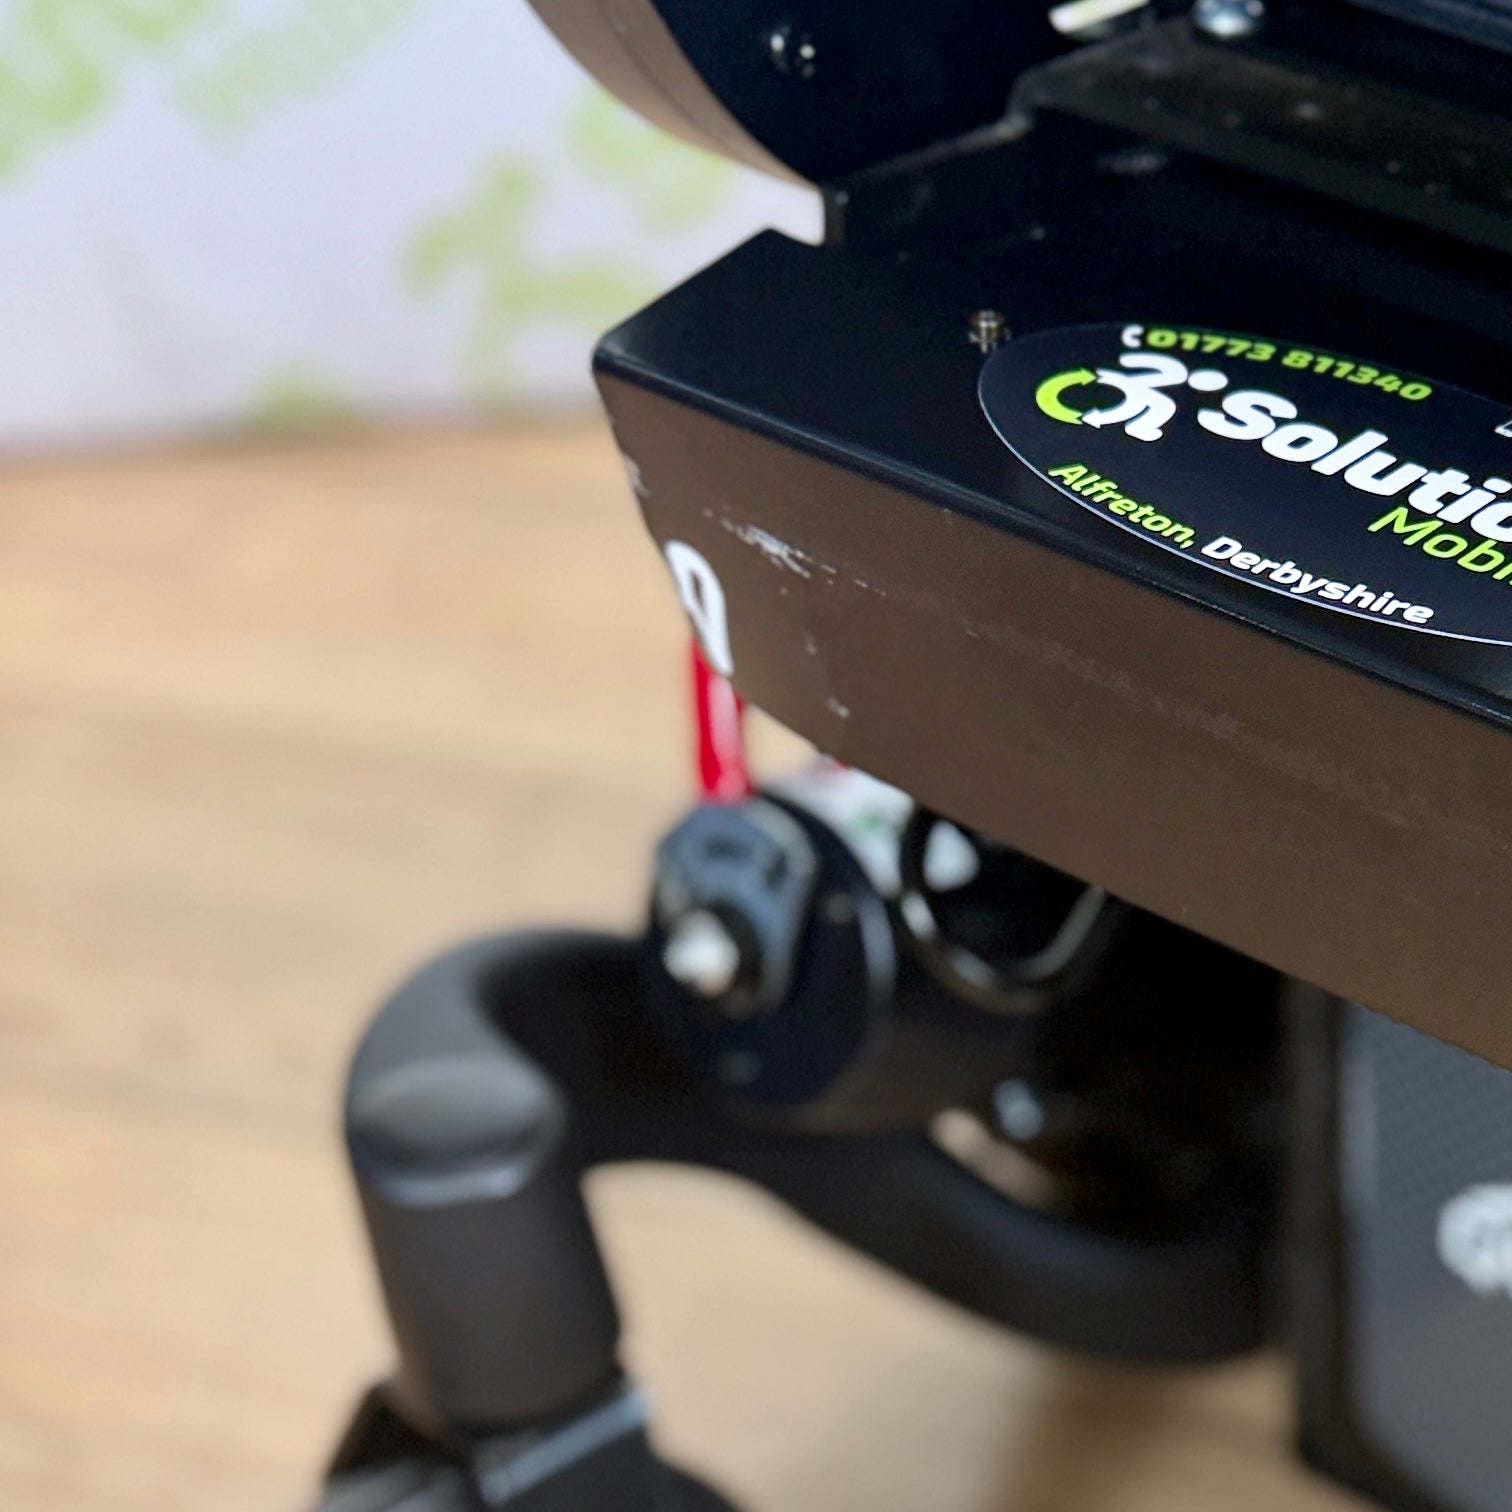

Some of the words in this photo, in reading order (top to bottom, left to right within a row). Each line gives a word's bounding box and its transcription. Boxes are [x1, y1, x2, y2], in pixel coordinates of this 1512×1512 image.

[1146, 328, 1277, 363] 01773
[1281, 349, 1433, 401] 811340
[1047, 462, 1196, 550] Alfreton,
[1200, 534, 1435, 624] Derbyshire
